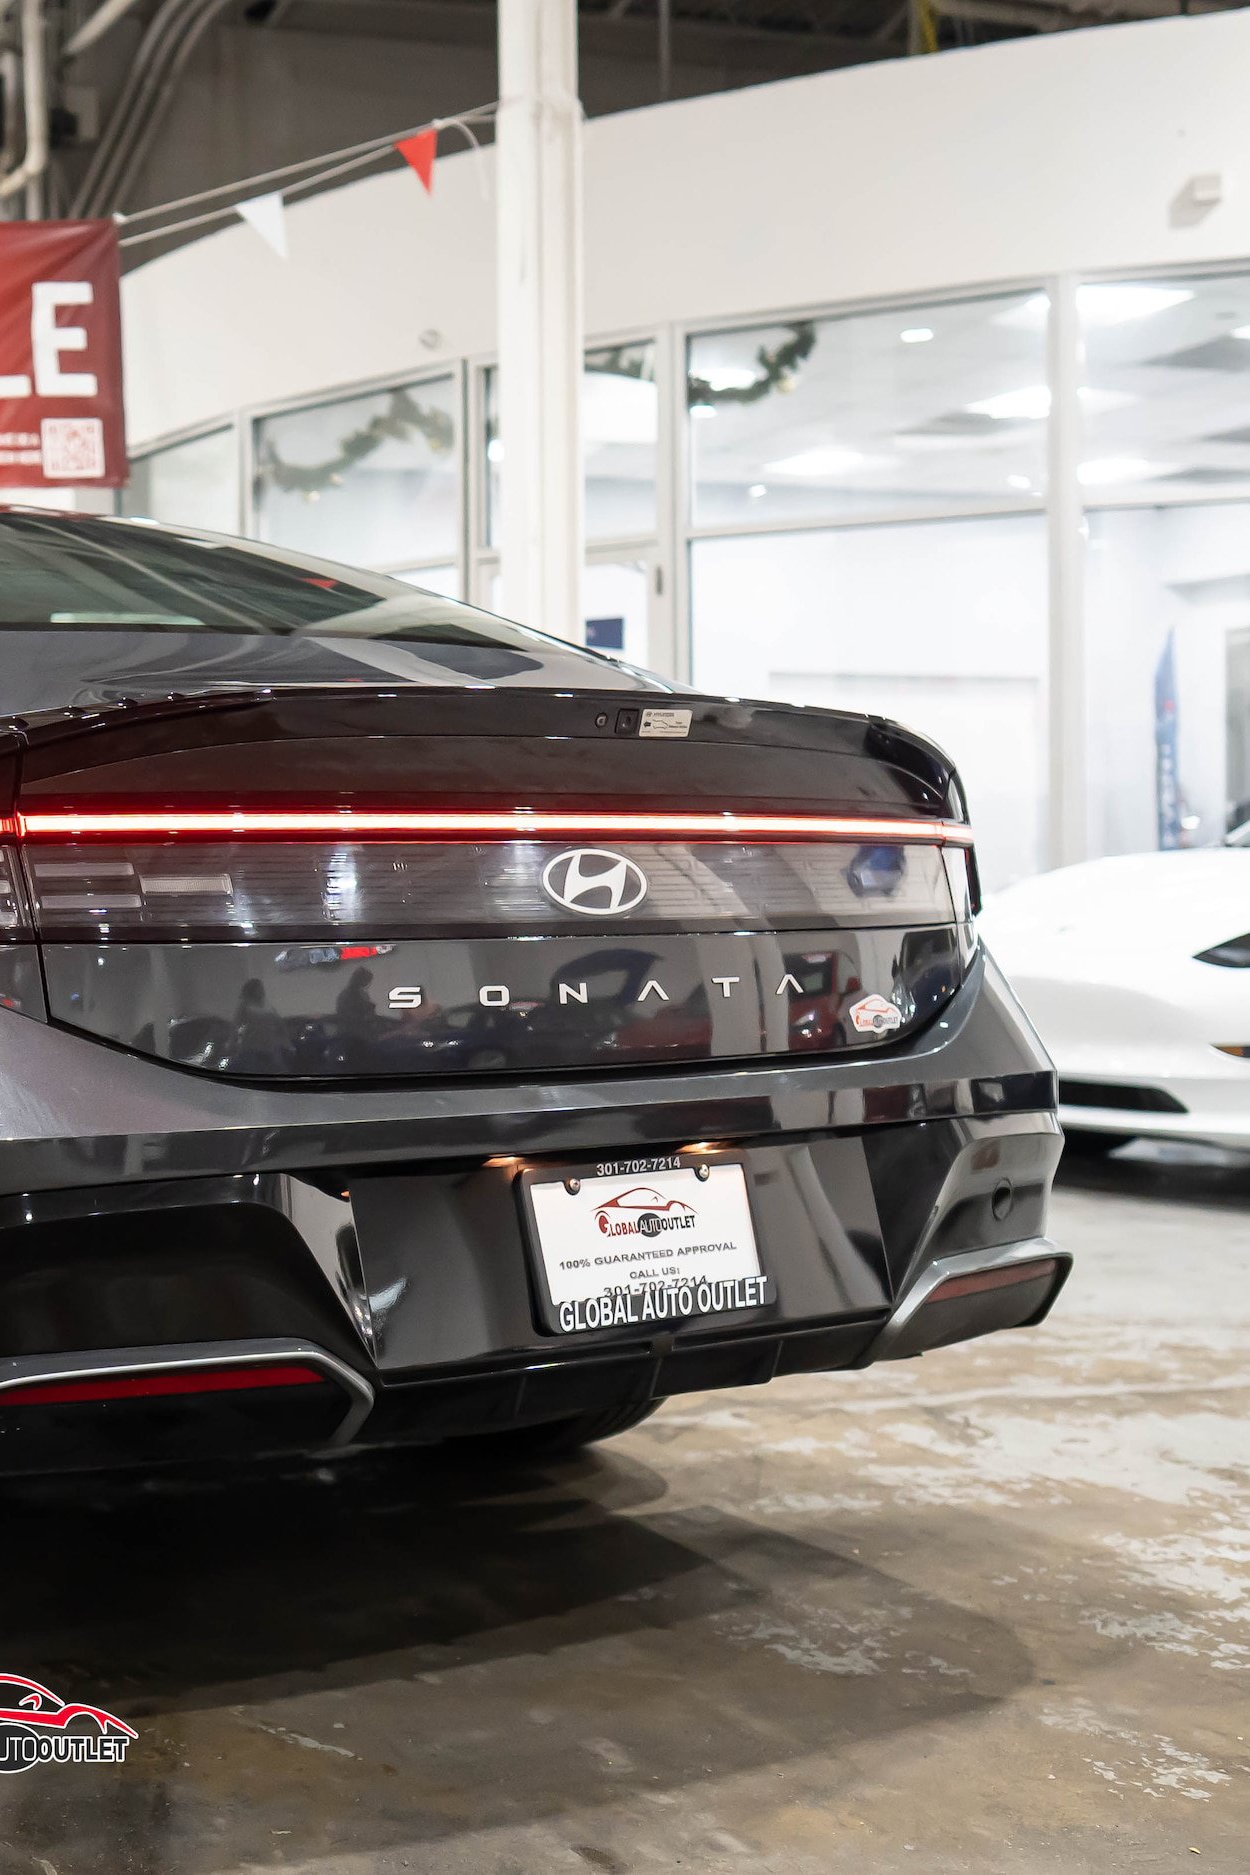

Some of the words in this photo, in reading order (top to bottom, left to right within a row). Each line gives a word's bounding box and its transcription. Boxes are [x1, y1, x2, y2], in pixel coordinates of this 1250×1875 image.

[388, 974, 804, 1008] SONATA
[596, 1156, 681, 1176] 301-702-7214
[559, 1258, 591, 1270] 100%
[594, 1248, 674, 1266] GUARANTEED
[677, 1242, 737, 1256] APPROVAL
[629, 1269, 659, 1280] CALL
[559, 1293, 638, 1332] GLOBAL
[641, 1285, 693, 1320] AUTO
[697, 1276, 768, 1313] OUTLET
